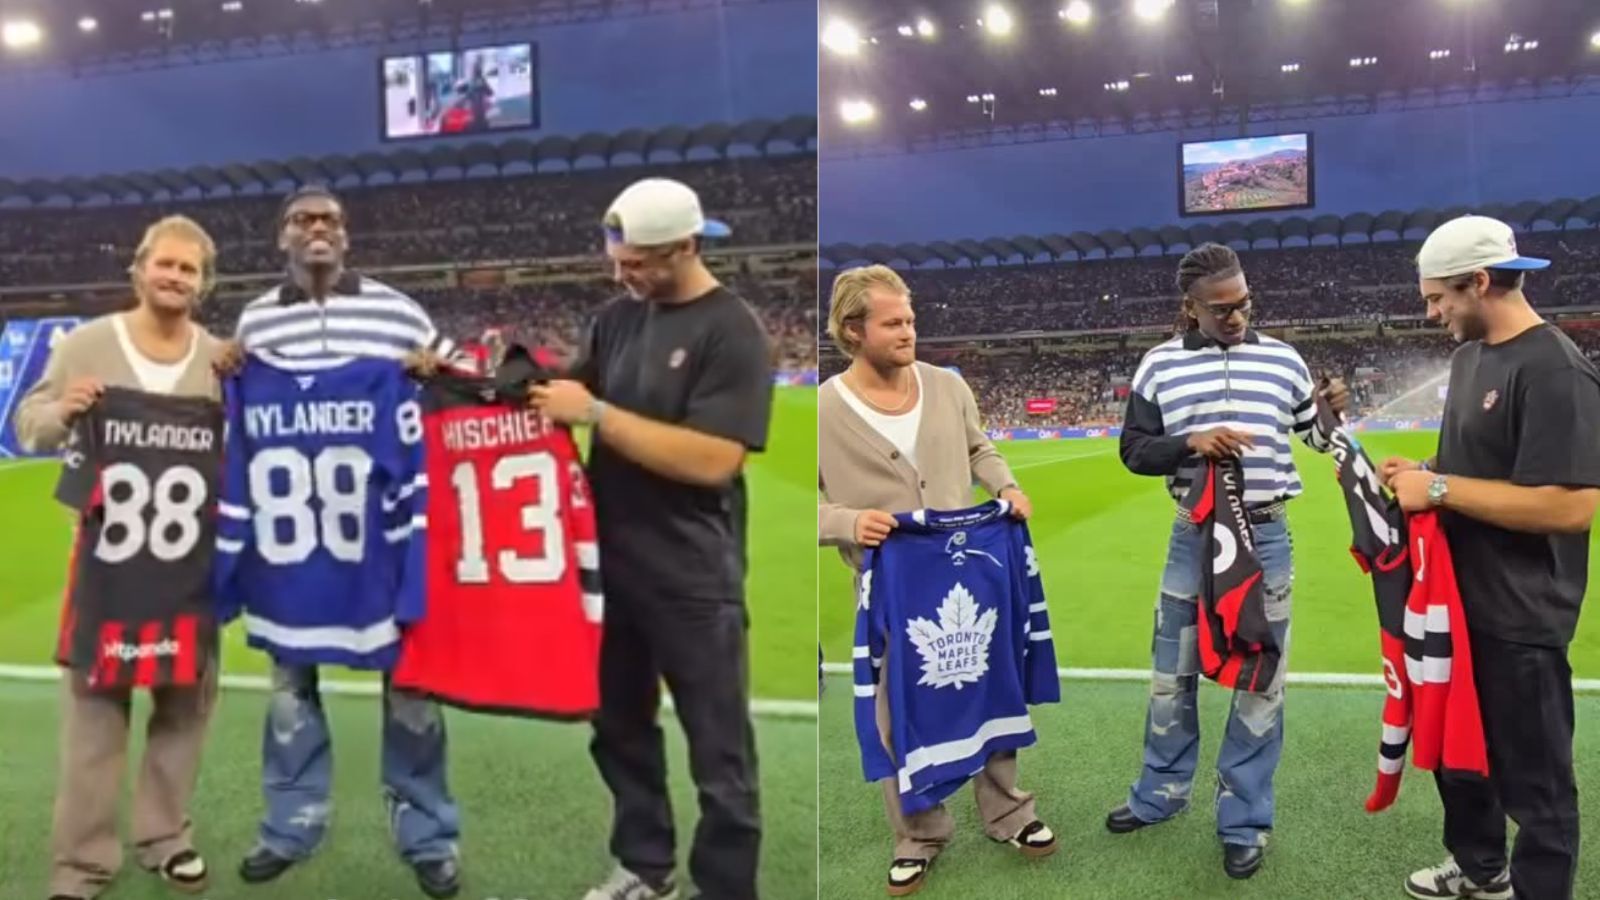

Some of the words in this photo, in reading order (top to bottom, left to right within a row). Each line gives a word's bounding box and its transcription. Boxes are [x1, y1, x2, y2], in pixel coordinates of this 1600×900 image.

[105, 419, 214, 451] NYLANDER
[244, 401, 375, 438] NYLANDER
[95, 462, 207, 563] 88
[249, 446, 374, 565] 88
[452, 450, 567, 583] 13
[927, 631, 987, 652] TORONTO
[938, 645, 978, 660] MAPLE
[937, 656, 978, 672] LEAFS
